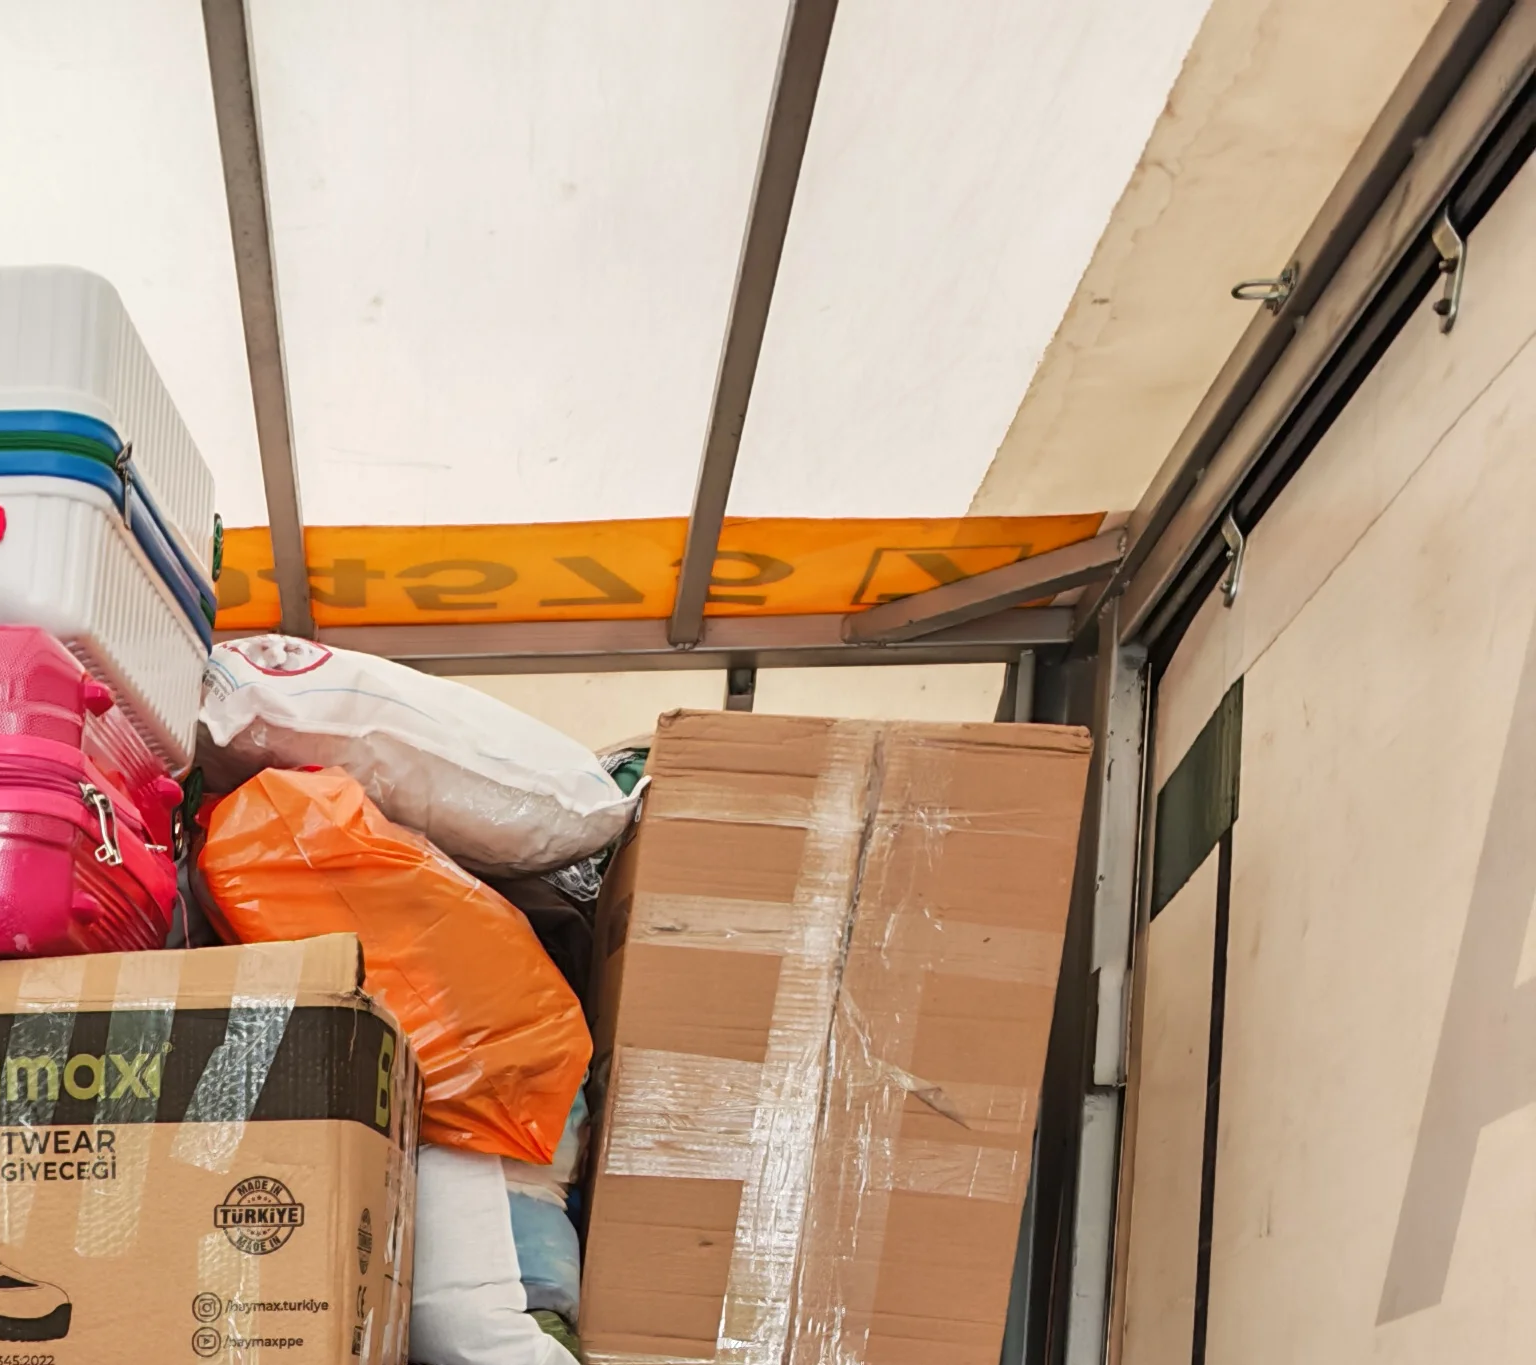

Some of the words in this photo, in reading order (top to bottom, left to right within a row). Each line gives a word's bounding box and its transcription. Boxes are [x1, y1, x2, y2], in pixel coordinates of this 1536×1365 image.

[1, 1155, 117, 1183] GİYECEĞİ
[238, 1179, 267, 1196] MADE
[270, 1180, 282, 1196] IN
